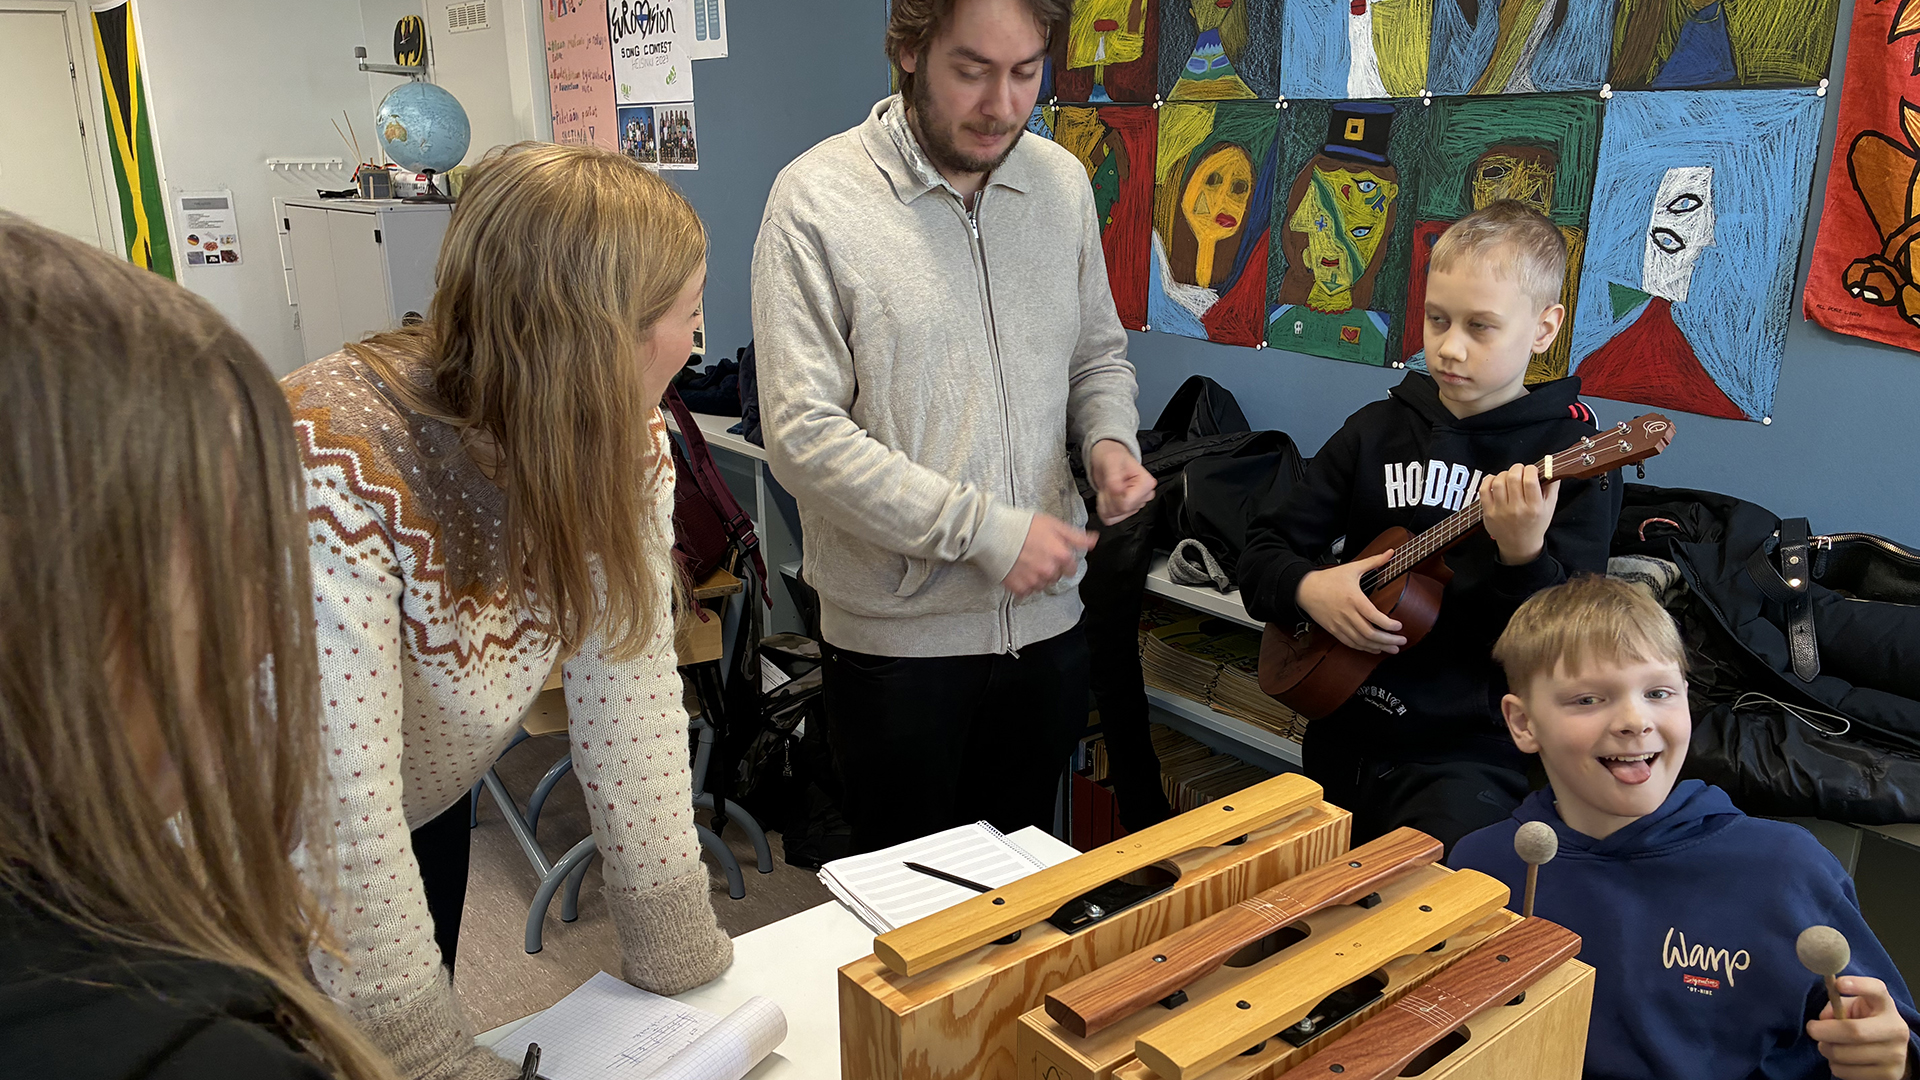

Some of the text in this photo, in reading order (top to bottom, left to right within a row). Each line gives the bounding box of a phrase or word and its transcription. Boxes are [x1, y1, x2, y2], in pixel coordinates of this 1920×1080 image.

[621, 40, 672, 59] SONG CONTEST
[1384, 459, 1483, 512] HODRI
[1662, 926, 1751, 988] Warp
